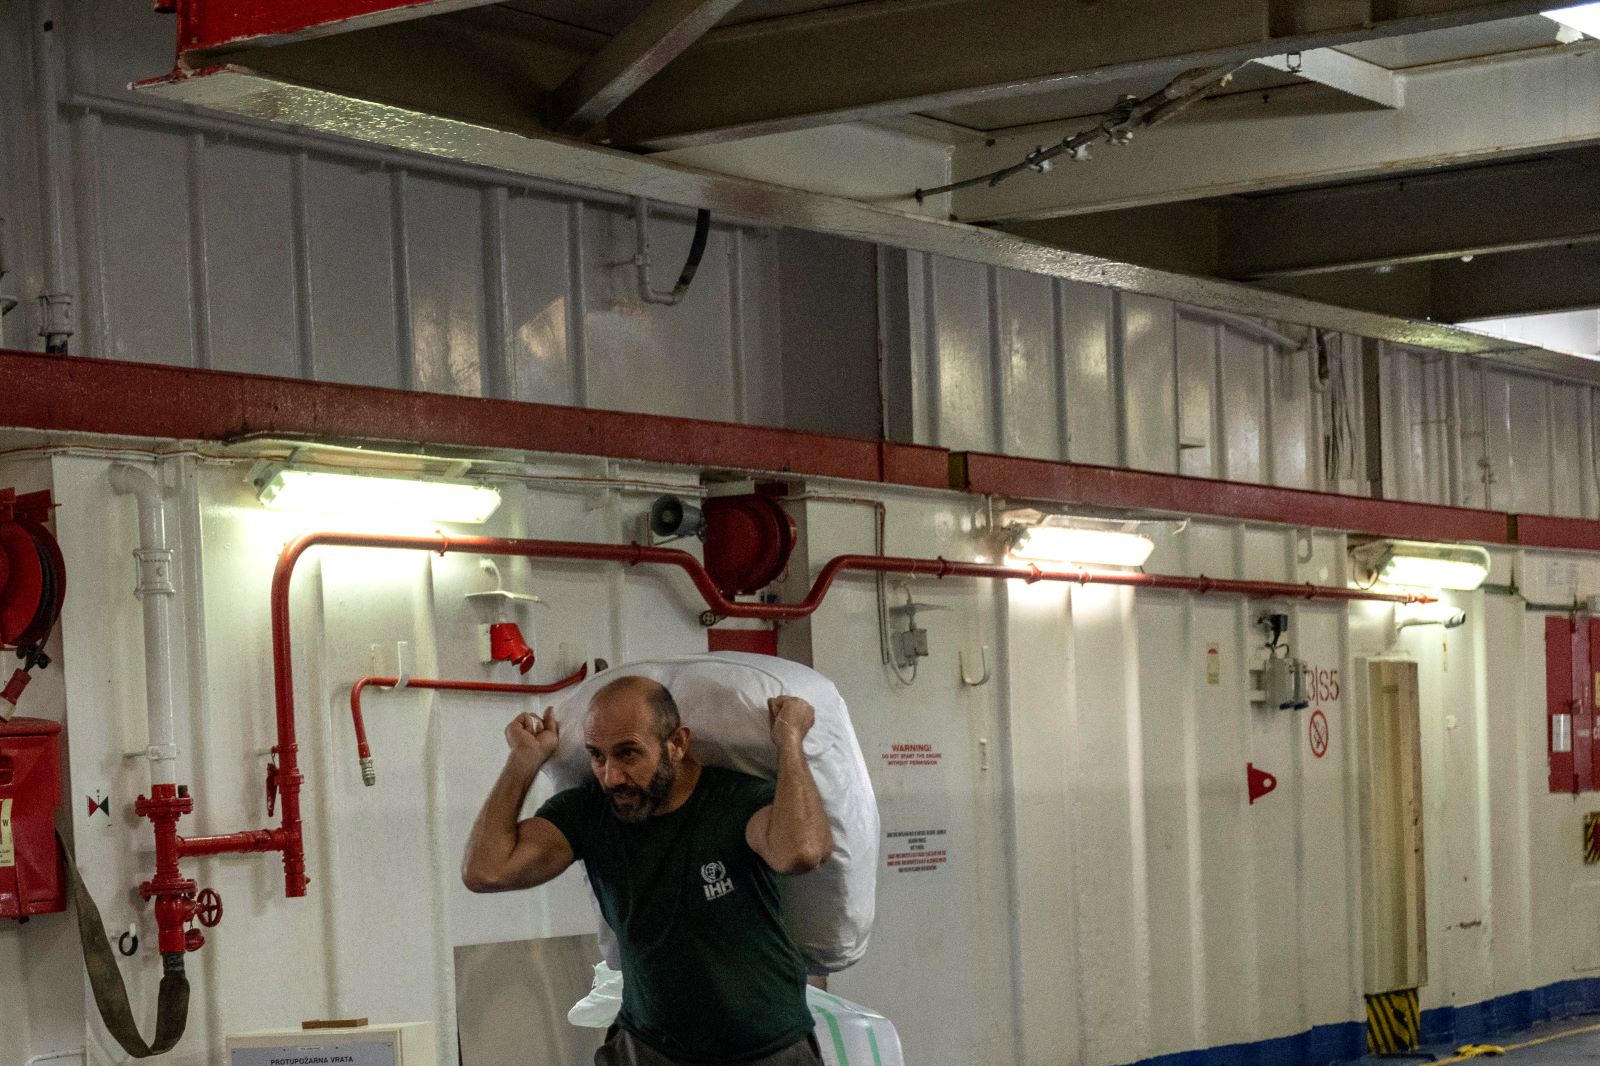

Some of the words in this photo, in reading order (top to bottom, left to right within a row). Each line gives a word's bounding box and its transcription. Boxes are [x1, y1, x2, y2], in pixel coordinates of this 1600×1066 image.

[891, 744, 932, 752] WARNING!
[2, 819, 9, 827] W
[270, 1057, 329, 1066] PROTUPOŽARNA
[330, 1056, 354, 1064] VRATA
